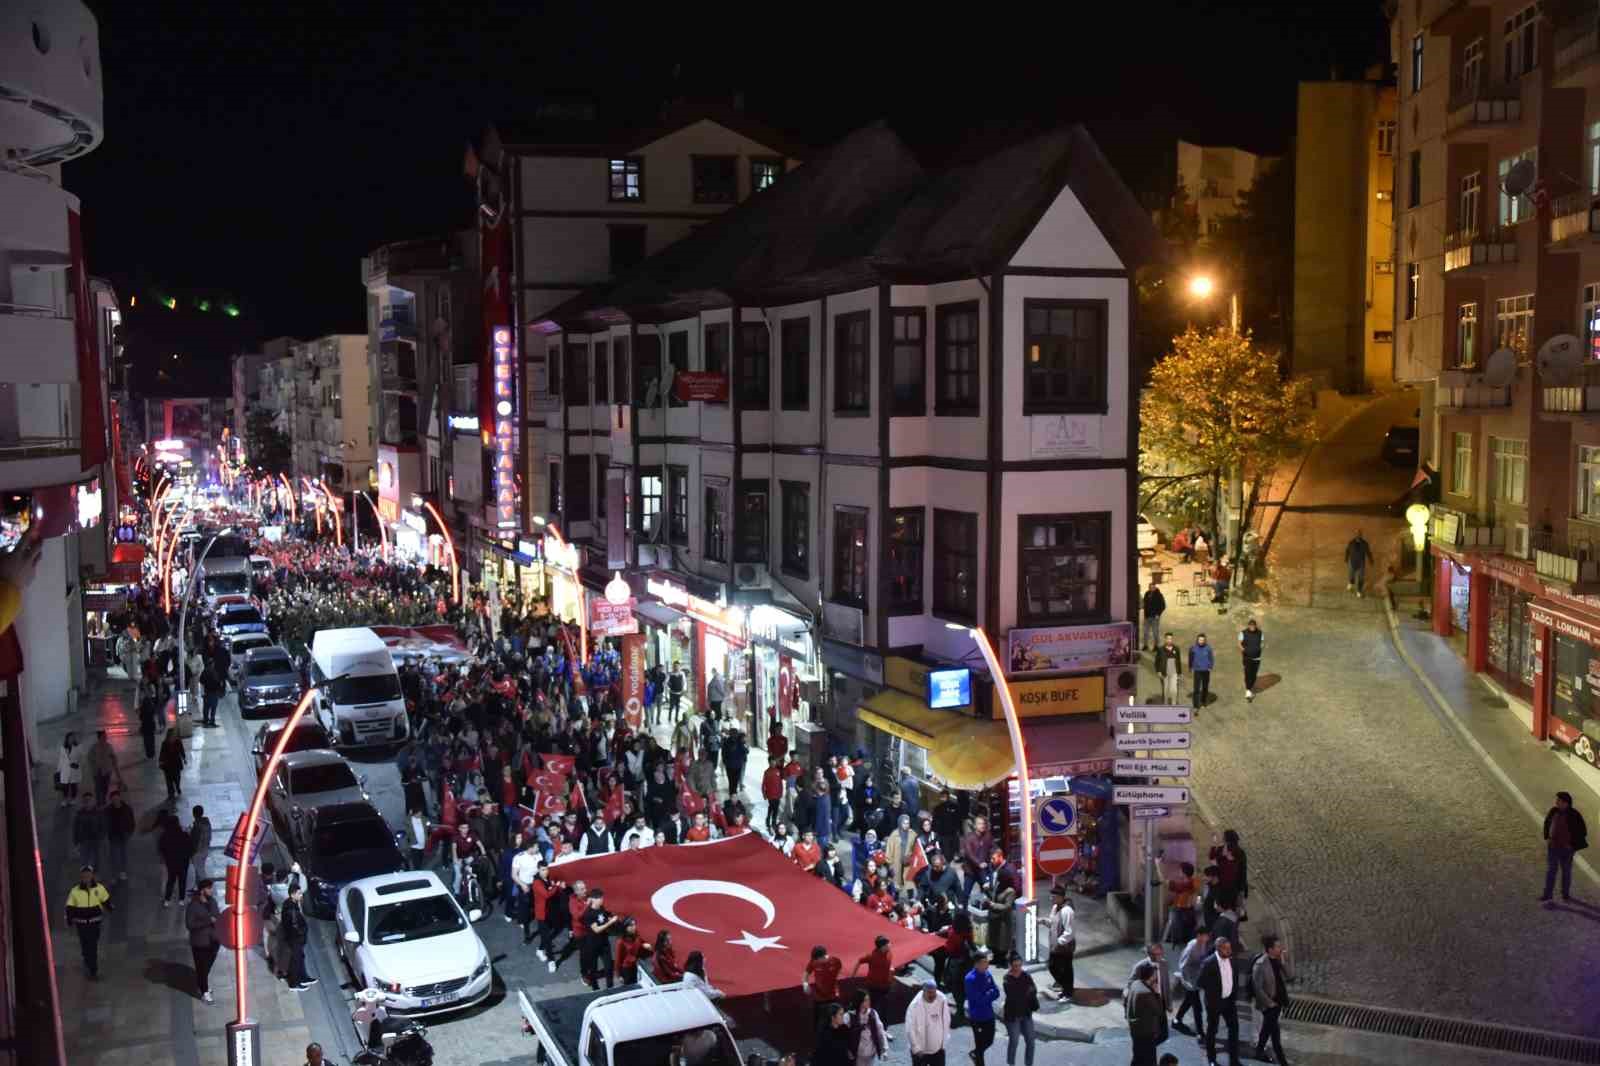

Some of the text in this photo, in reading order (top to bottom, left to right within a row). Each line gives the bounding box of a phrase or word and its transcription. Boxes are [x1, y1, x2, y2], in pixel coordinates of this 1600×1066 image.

[498, 420, 513, 519] ATALAY
[1556, 620, 1590, 640] LOKMAN
[1119, 711, 1147, 719] Valilik
[1116, 791, 1164, 800] Kütüphane
